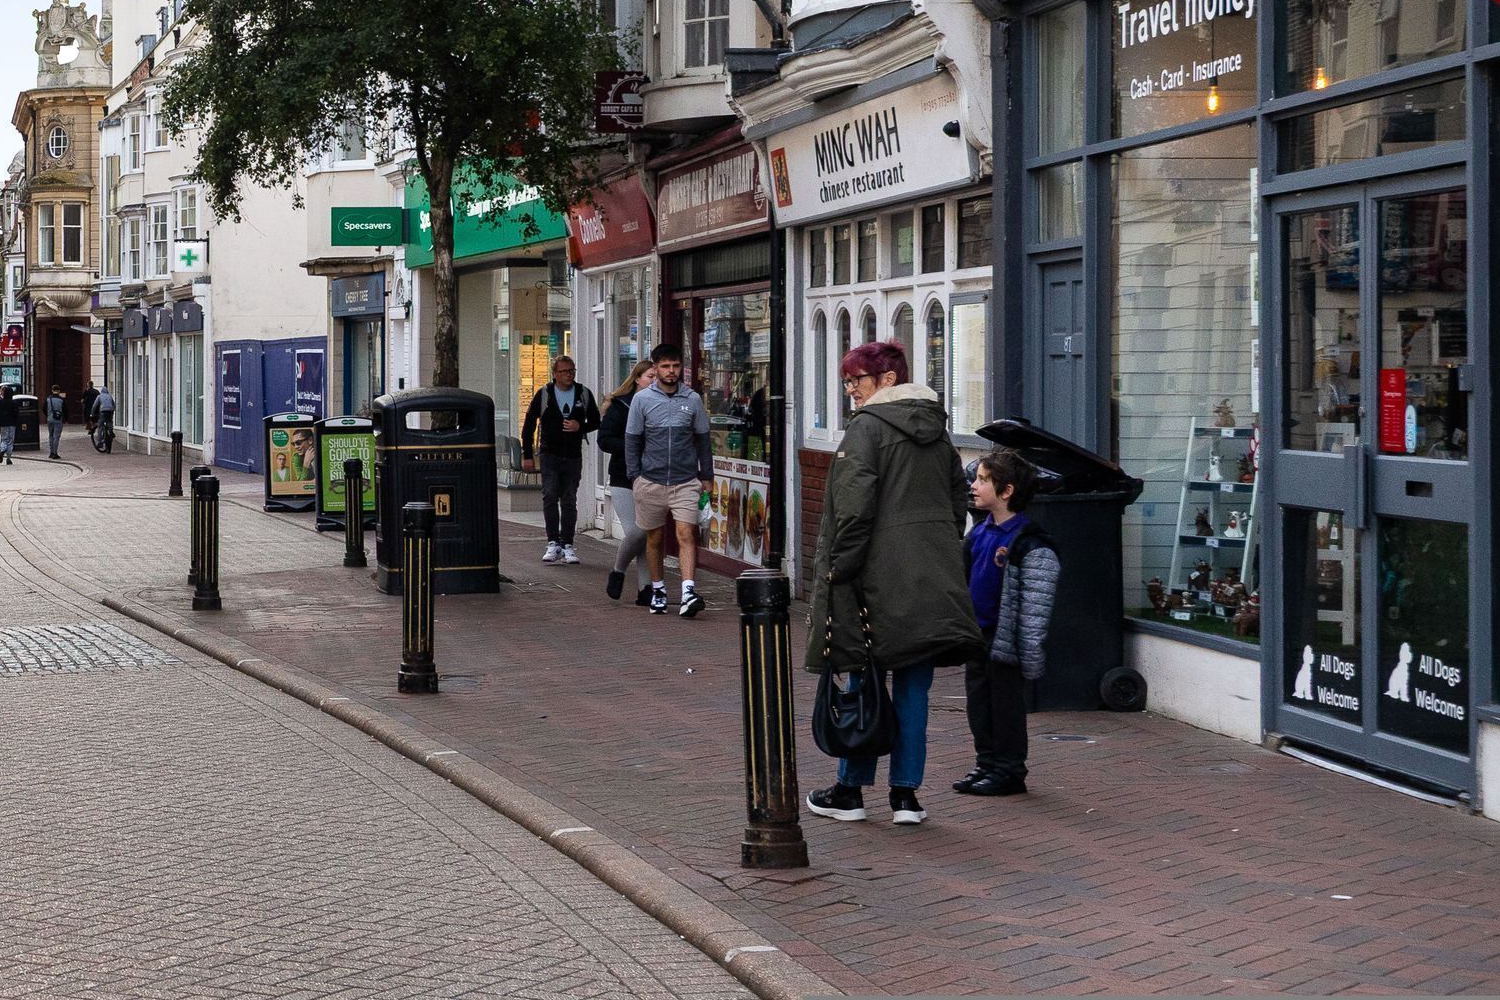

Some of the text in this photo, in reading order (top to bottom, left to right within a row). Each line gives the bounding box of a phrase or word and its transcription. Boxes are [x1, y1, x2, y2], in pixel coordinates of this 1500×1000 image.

[1130, 74, 1153, 100] Cash
[1160, 65, 1184, 91] Card
[1192, 53, 1242, 82] Insurance
[620, 105, 633, 113] CAFE
[814, 106, 901, 177] MING WAH
[713, 150, 755, 201] RESTAURANT
[820, 162, 905, 203] chinese restaurant
[344, 221, 392, 231] Specsavers
[345, 289, 369, 304] CHERRY TREE
[1063, 336, 1072, 352] 87
[328, 437, 370, 449] SHOULD'VE
[329, 447, 370, 461] GONE TO
[1320, 654, 1356, 681] All Dogs
[1419, 654, 1461, 687] All Dogs
[1317, 685, 1360, 711] Welcome
[1415, 687, 1465, 721] Welcome
